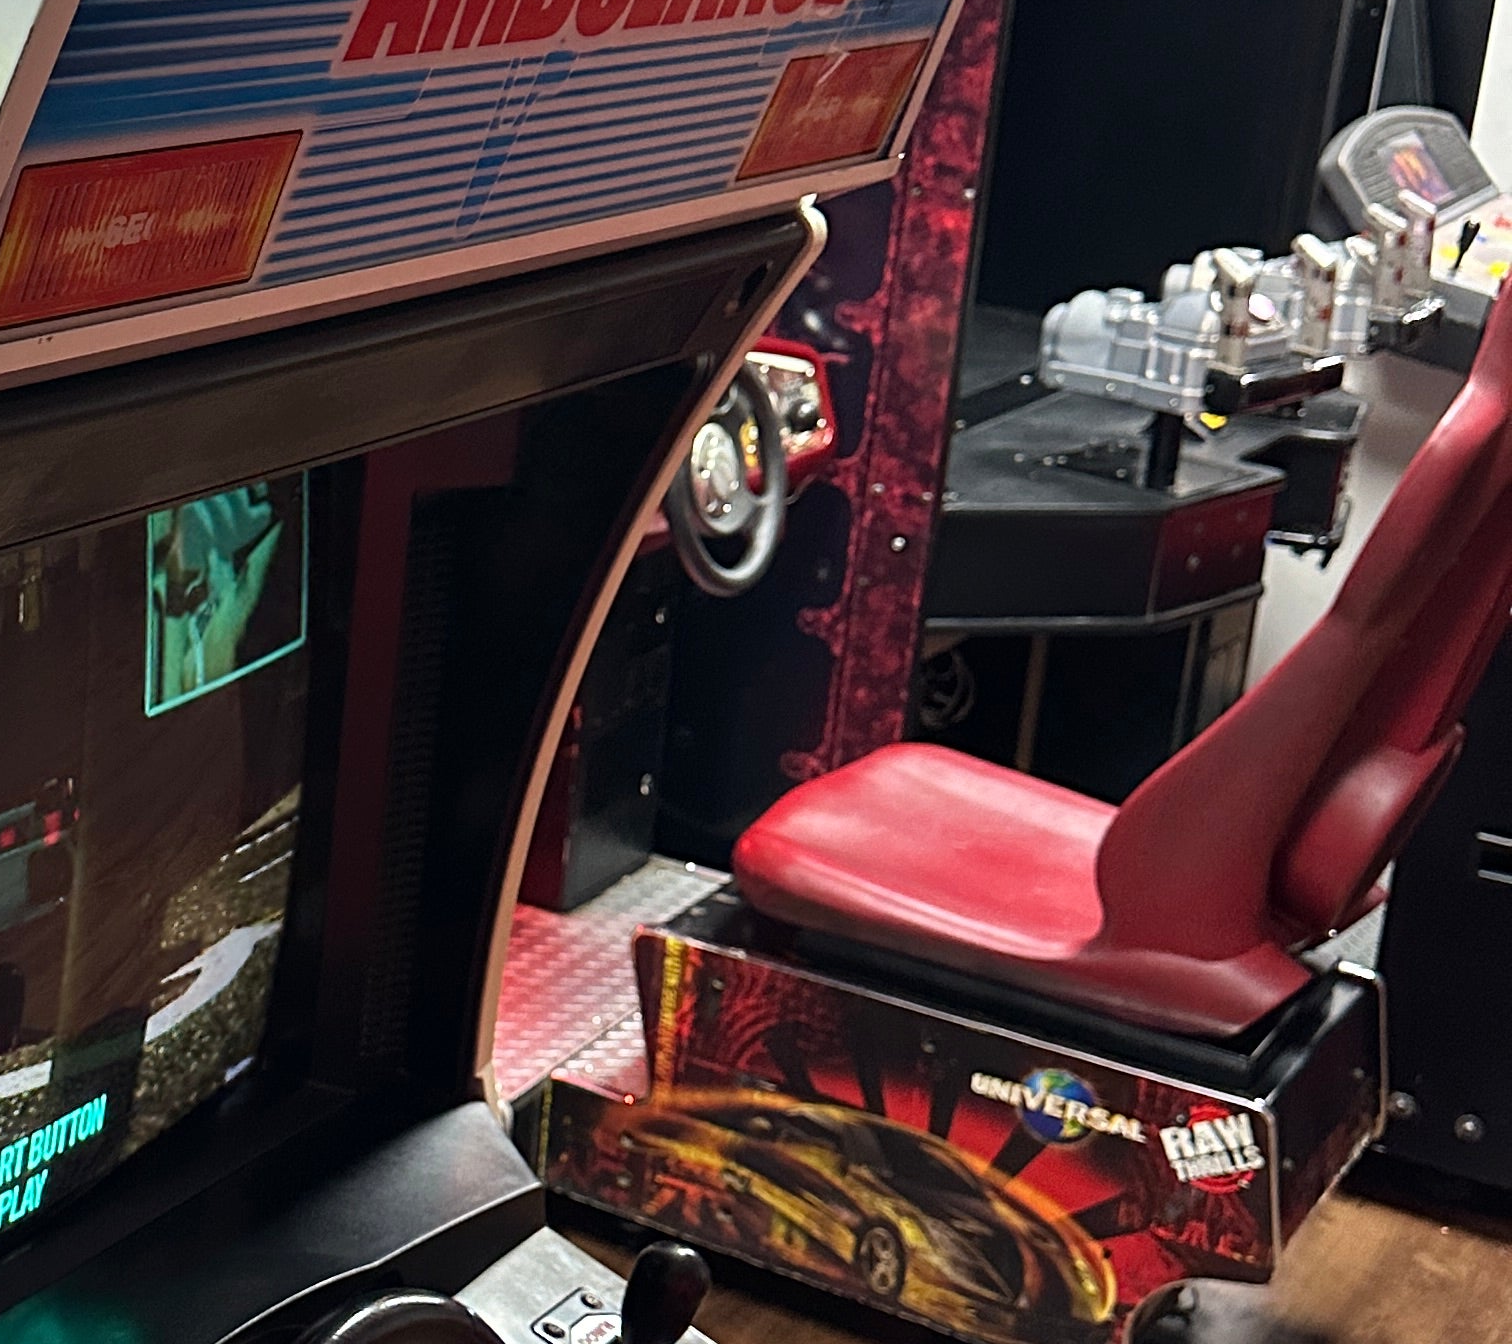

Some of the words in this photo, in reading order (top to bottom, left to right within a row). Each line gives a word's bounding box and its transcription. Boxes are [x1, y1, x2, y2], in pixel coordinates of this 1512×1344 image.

[27, 1092, 107, 1171] BUTTON
[970, 1072, 1148, 1145] UNIVERSAL
[1159, 1112, 1255, 1161] RAW
